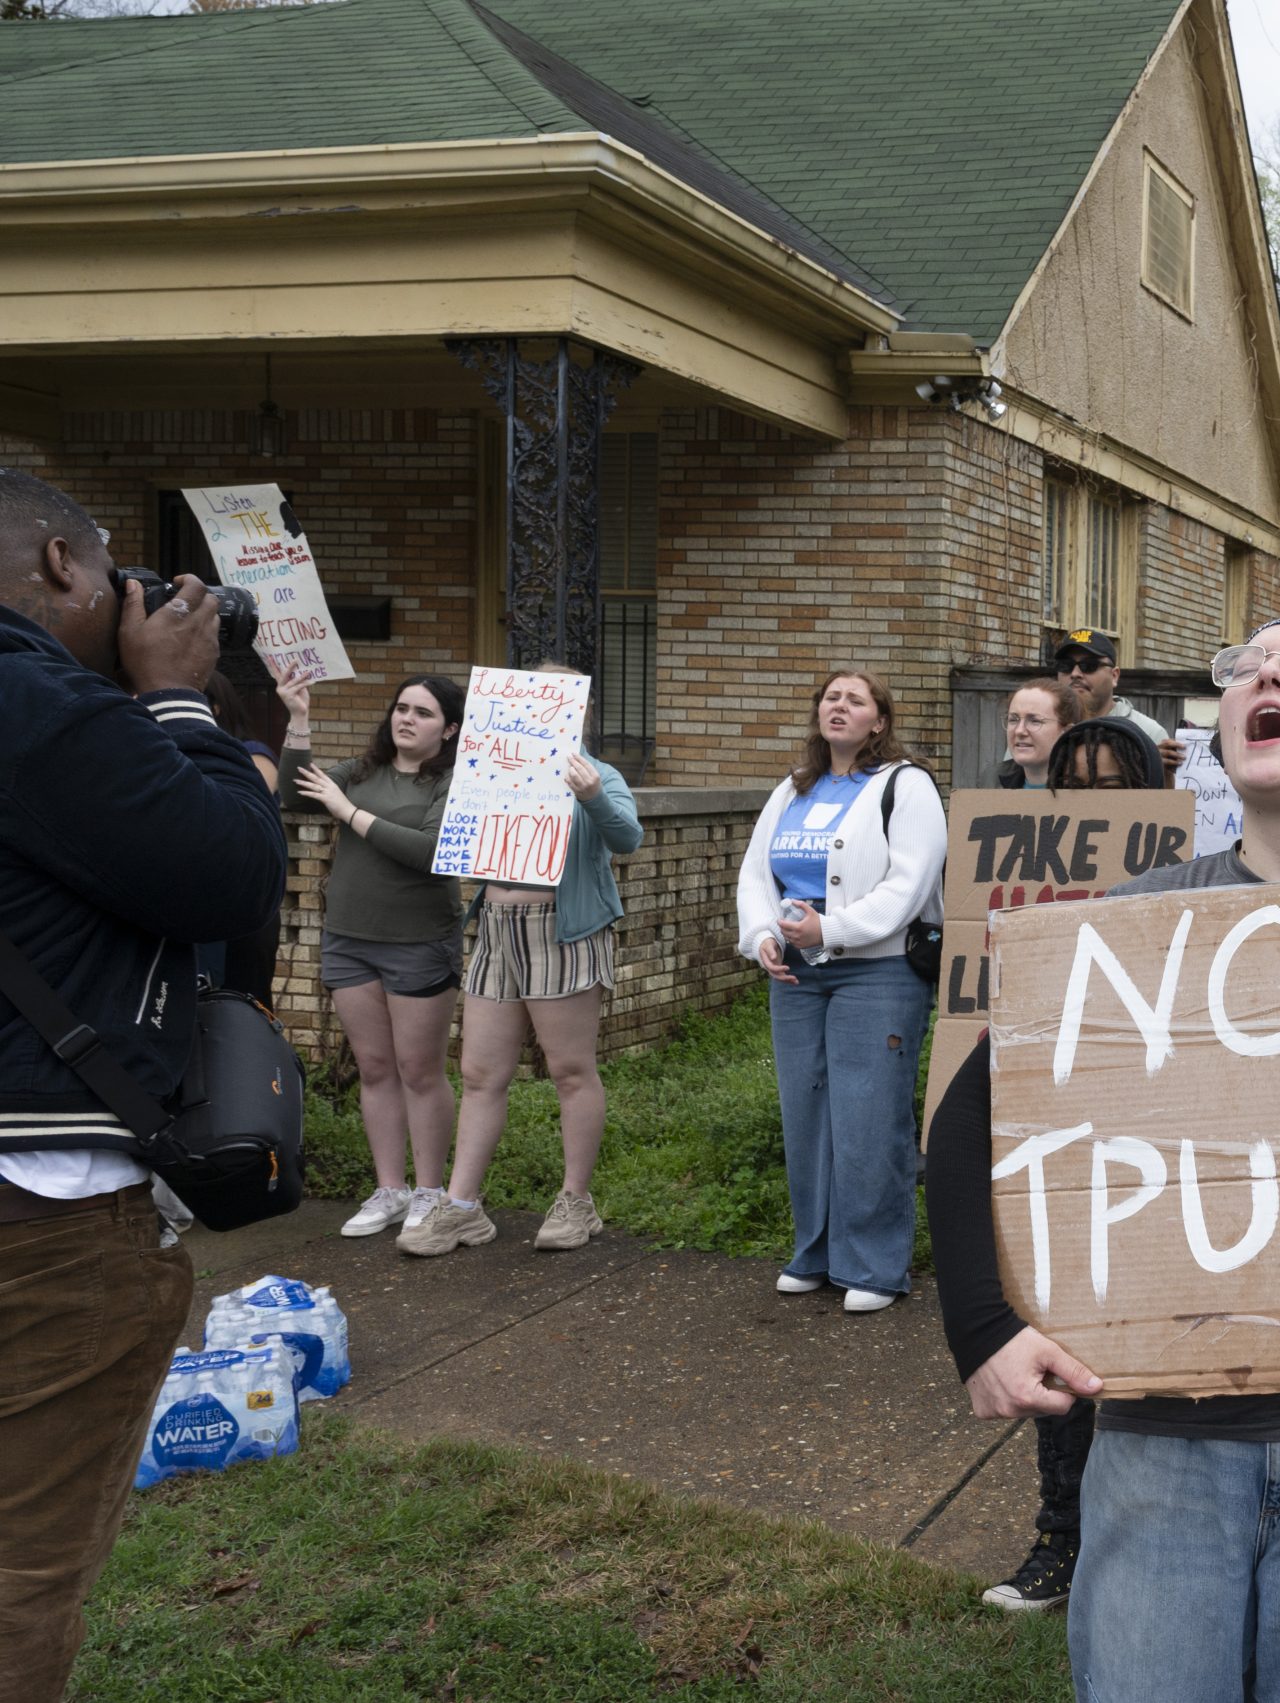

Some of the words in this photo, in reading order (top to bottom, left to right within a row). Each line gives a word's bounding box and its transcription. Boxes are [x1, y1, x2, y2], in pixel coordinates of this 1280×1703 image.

[201, 490, 256, 514] Listen
[205, 518, 227, 542] 2
[230, 511, 281, 540] THE
[274, 587, 296, 604] are
[473, 670, 575, 724] Liberty
[474, 701, 556, 740] Justice
[461, 735, 485, 753] for
[496, 787, 532, 803] people
[537, 789, 561, 801] who
[447, 812, 479, 825] LOOK
[443, 825, 478, 837] WORK
[437, 850, 472, 860] LOVE
[473, 814, 530, 881] LIKE
[521, 814, 572, 882] YOU
[968, 814, 1110, 885] TAKE
[434, 862, 472, 875] LIVE
[255, 1393, 271, 1404] 24
[165, 1413, 223, 1430] DRINKING
[166, 1408, 221, 1422] PURIFIED
[156, 1421, 234, 1447] WATER
